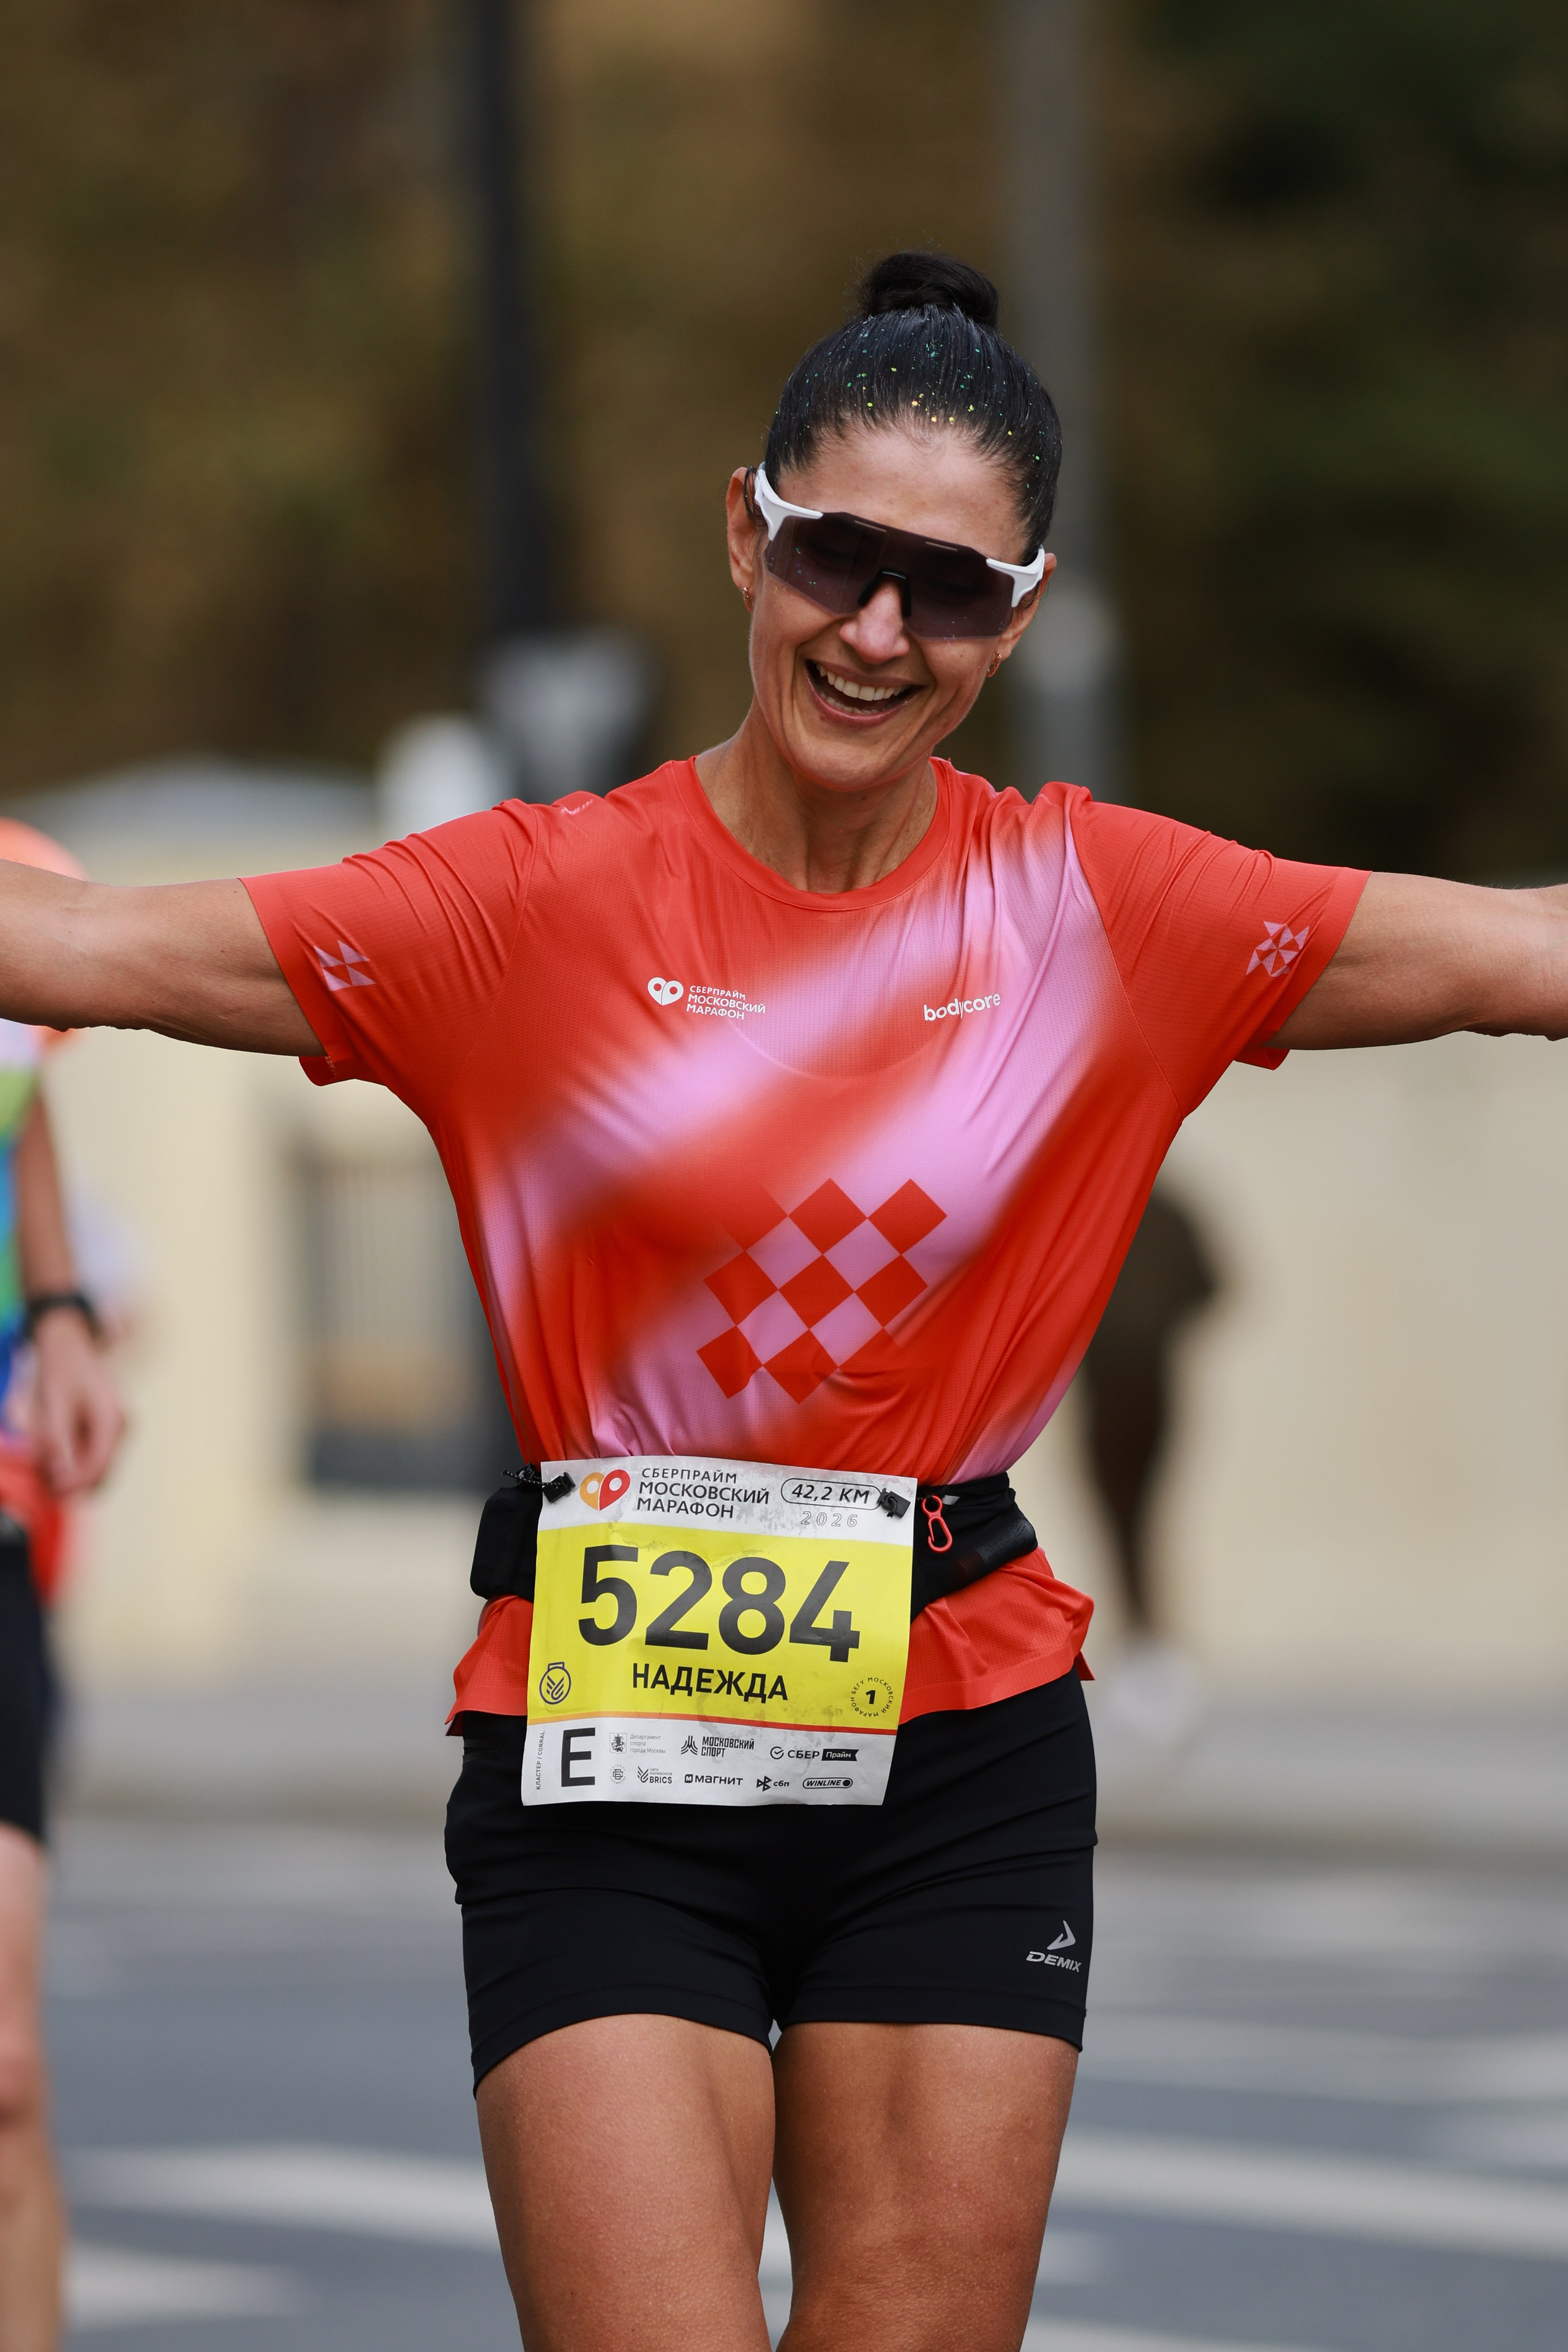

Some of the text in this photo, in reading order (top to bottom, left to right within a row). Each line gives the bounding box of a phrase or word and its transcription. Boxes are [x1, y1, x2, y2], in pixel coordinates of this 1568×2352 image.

[690, 986, 745, 1000] СБЕРПРАЙМ
[686, 1004, 745, 1020] МАРАФОН
[688, 993, 766, 1014] МОСКОВСКИЙ
[924, 993, 1000, 1021] bodycore
[642, 1468, 737, 1483] СБЕРПРАЙМ
[639, 1482, 769, 1504] МОСКОВСКИЙ
[791, 1483, 832, 1501] 42,2
[637, 1498, 734, 1518] МАРАФОН
[801, 1510, 858, 1528] 2026
[578, 1544, 860, 1663] 5284
[632, 1663, 788, 1704] НАДЕЖДА
[850, 1677, 894, 1717] БЕГУ МОСКОВСКИЙ МАРАФОН
[865, 1690, 876, 1705] 1
[701, 1747, 725, 1757] СПОРТ
[702, 1736, 755, 1750] МОСКОВСКИЙ
[788, 1749, 820, 1759] СБЕР
[1026, 1951, 1082, 1972] DEMIX
